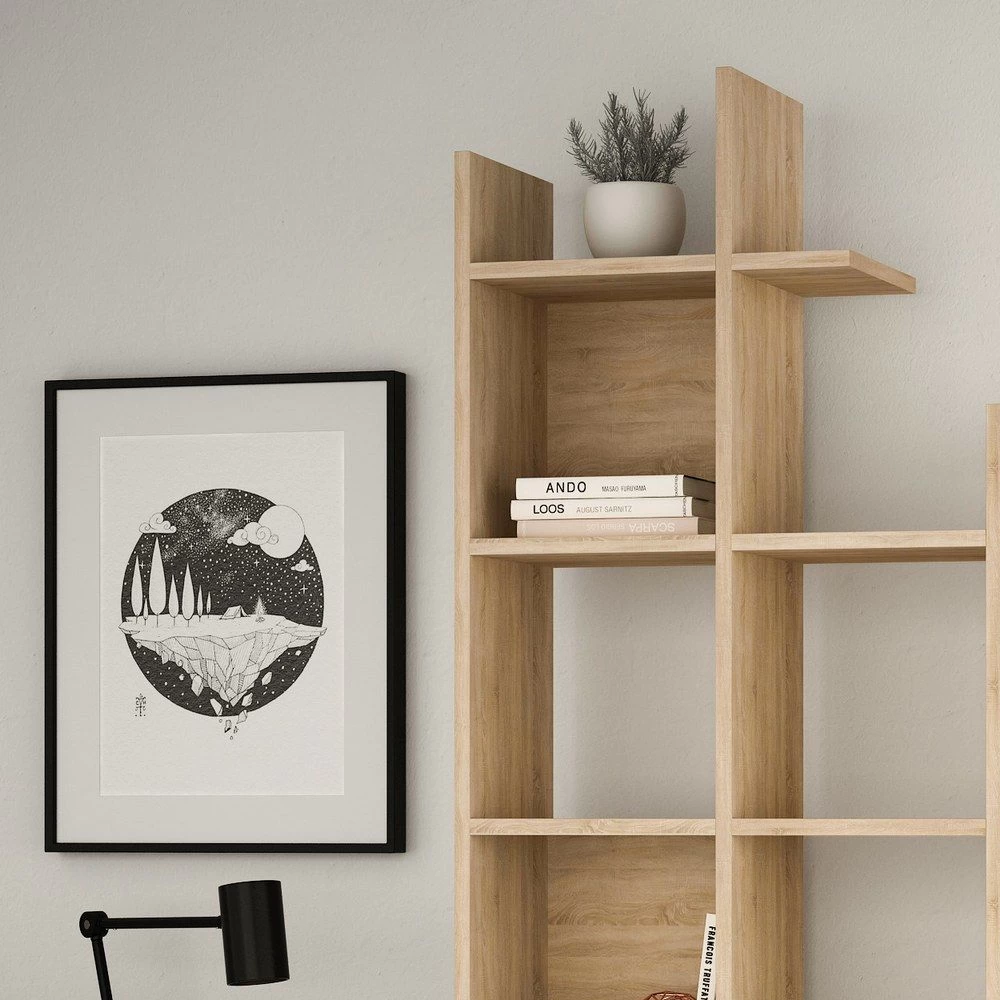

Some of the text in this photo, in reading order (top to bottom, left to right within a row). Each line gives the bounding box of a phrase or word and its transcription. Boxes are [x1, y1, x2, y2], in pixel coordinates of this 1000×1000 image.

[546, 482, 587, 494] ANDO
[533, 504, 565, 515] LOOS
[604, 505, 633, 513] SARNITZ
[629, 522, 676, 533] SCARPA
[700, 926, 717, 1000] FRANCOIS TRUFFAT
